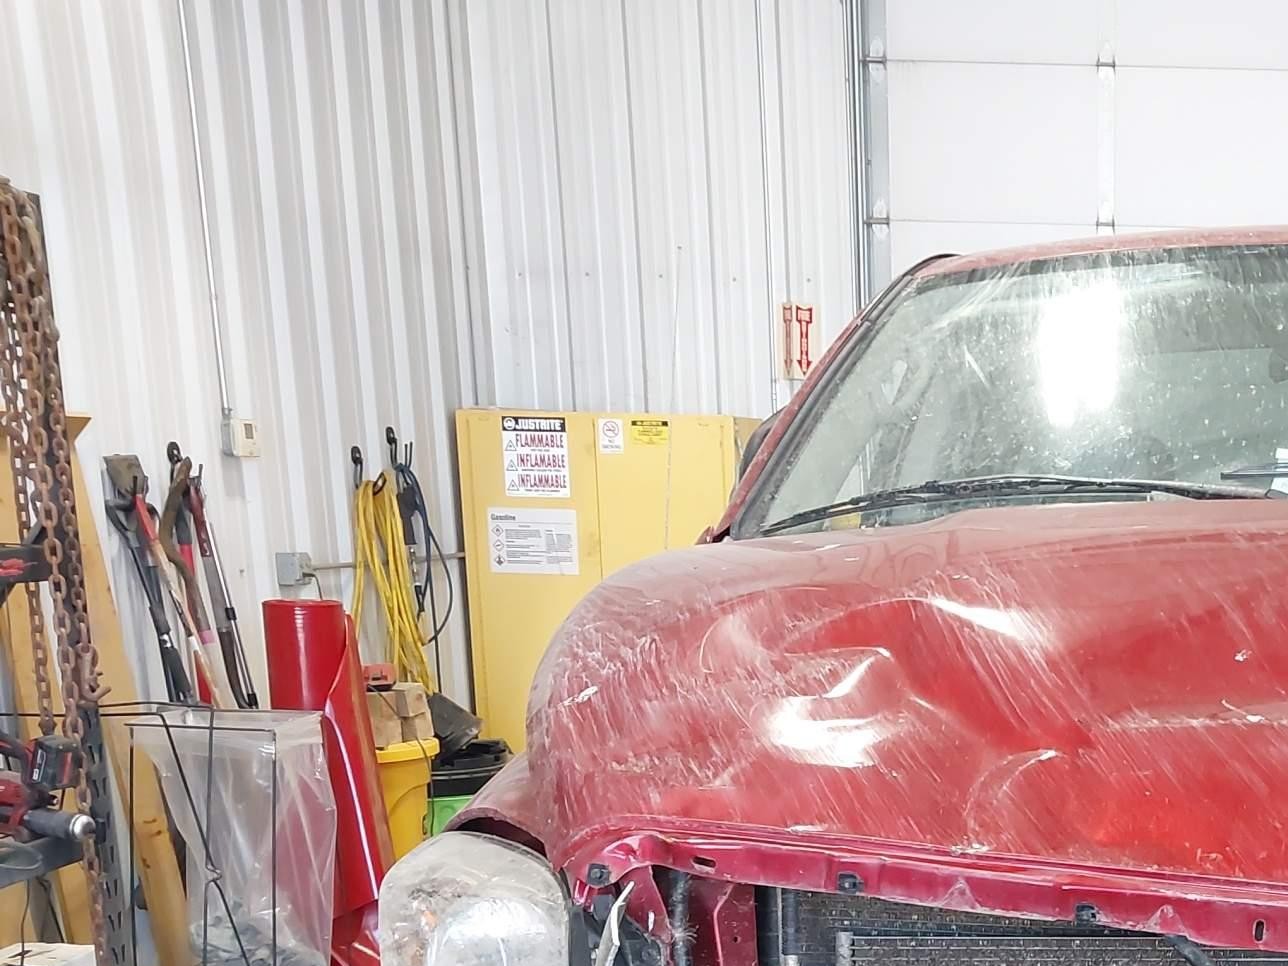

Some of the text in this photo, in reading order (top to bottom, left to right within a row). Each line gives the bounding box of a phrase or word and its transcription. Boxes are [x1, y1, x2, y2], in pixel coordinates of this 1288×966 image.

[515, 419, 562, 431] JUSTRITE
[515, 433, 564, 448] FLAMMABLE
[517, 453, 566, 469] INFLAMABLE
[518, 473, 568, 489] INFLAMMABLE
